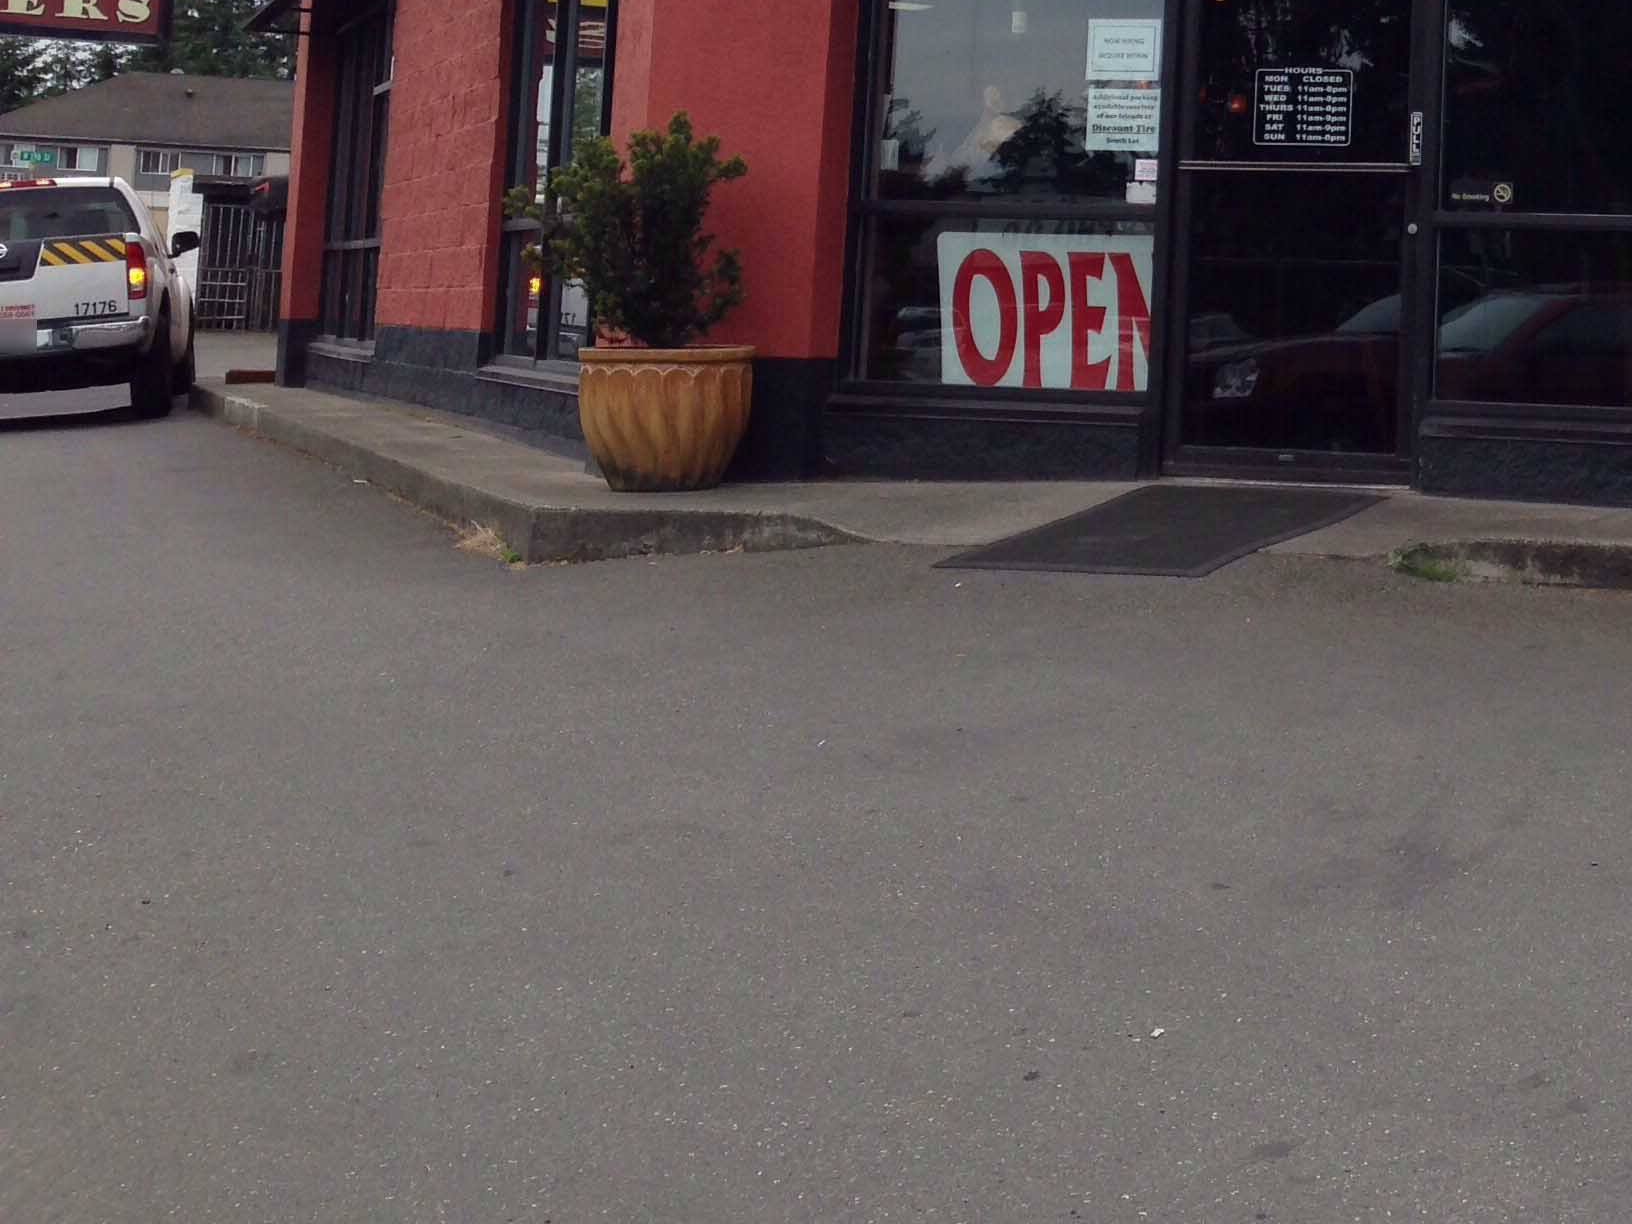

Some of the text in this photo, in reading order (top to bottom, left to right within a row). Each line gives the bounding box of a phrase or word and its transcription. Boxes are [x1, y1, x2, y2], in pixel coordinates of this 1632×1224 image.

[1302, 75, 1343, 83] CLOSED
[1263, 94, 1287, 102] WED
[1259, 104, 1294, 112] THURS
[1092, 123, 1155, 133] Discount Tire
[1264, 123, 1285, 131] SAT
[1412, 116, 1421, 153] PULL
[74, 300, 117, 317] 17176
[952, 248, 1150, 392] OPEN
